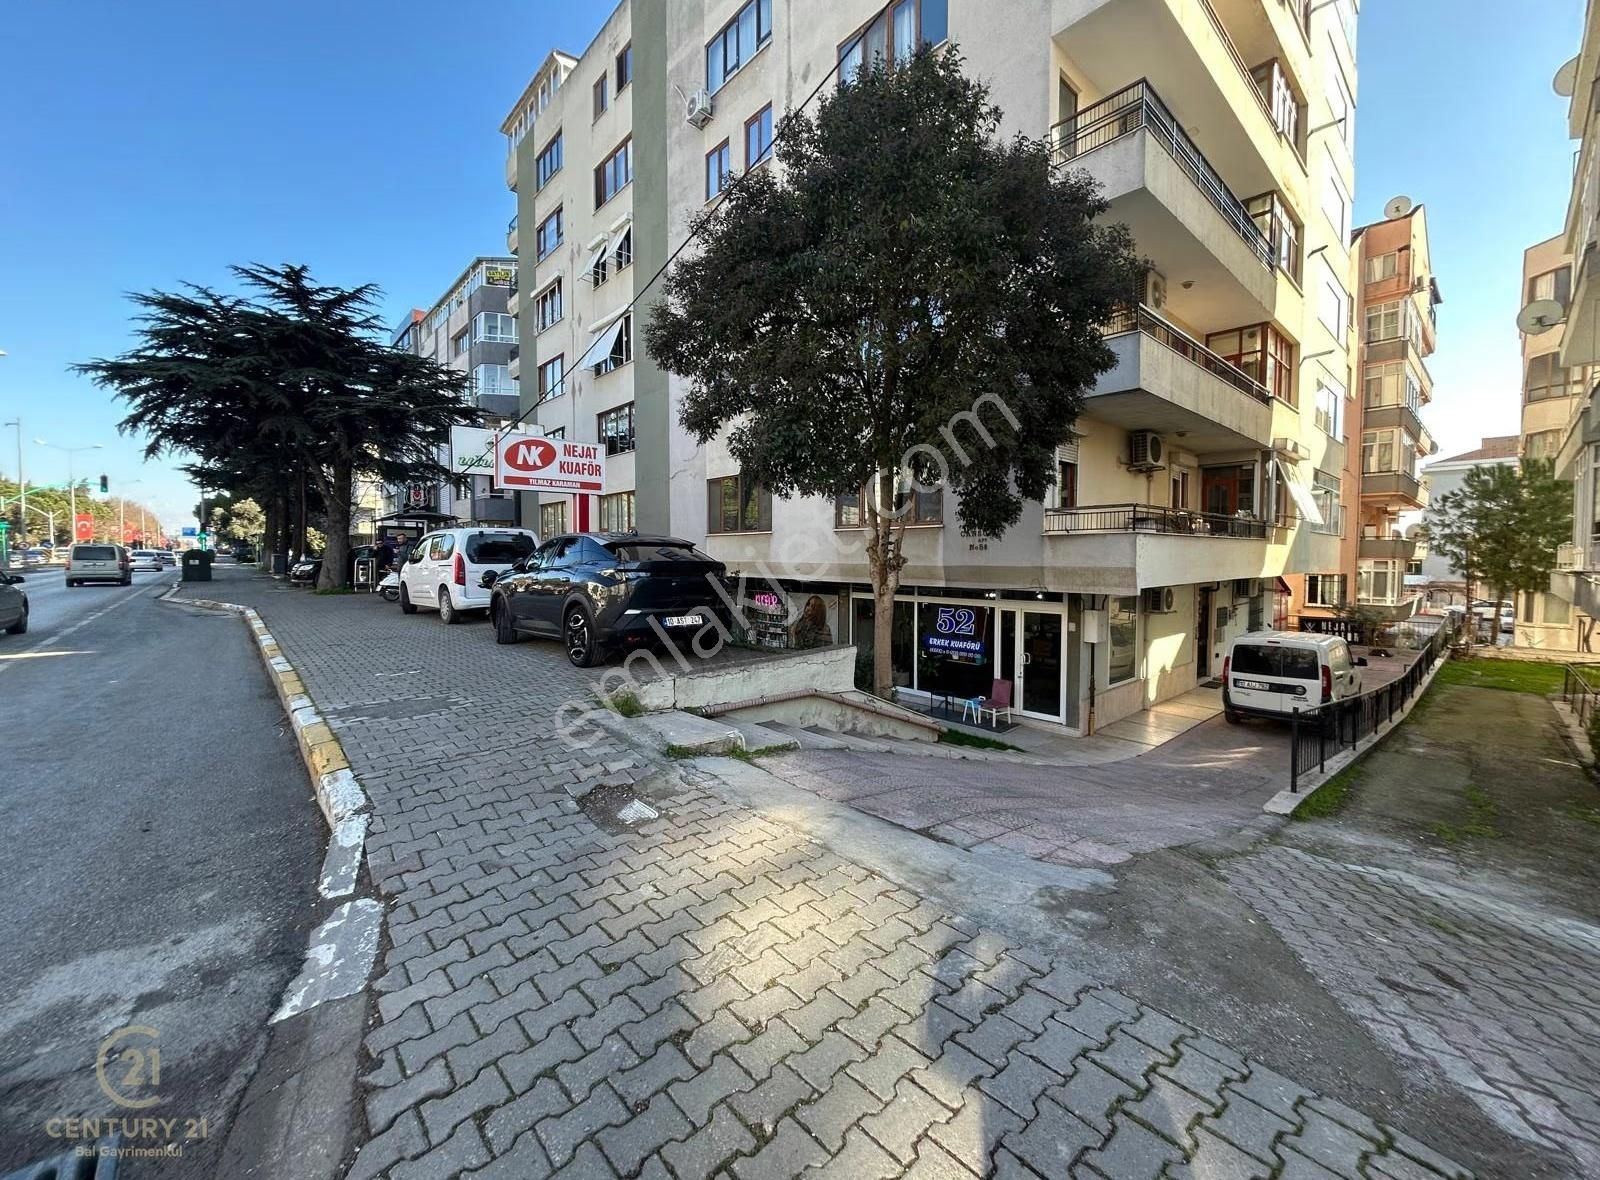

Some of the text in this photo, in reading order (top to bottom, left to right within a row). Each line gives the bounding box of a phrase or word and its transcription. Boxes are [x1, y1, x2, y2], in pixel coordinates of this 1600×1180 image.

[516, 444, 545, 467] NK
[563, 443, 598, 460] NEJAT
[559, 460, 602, 477] KUAFÖR
[552, 480, 581, 489] KARAMAN
[937, 607, 975, 635] 52
[929, 637, 981, 651] ERKEK KUAFÖRÜ
